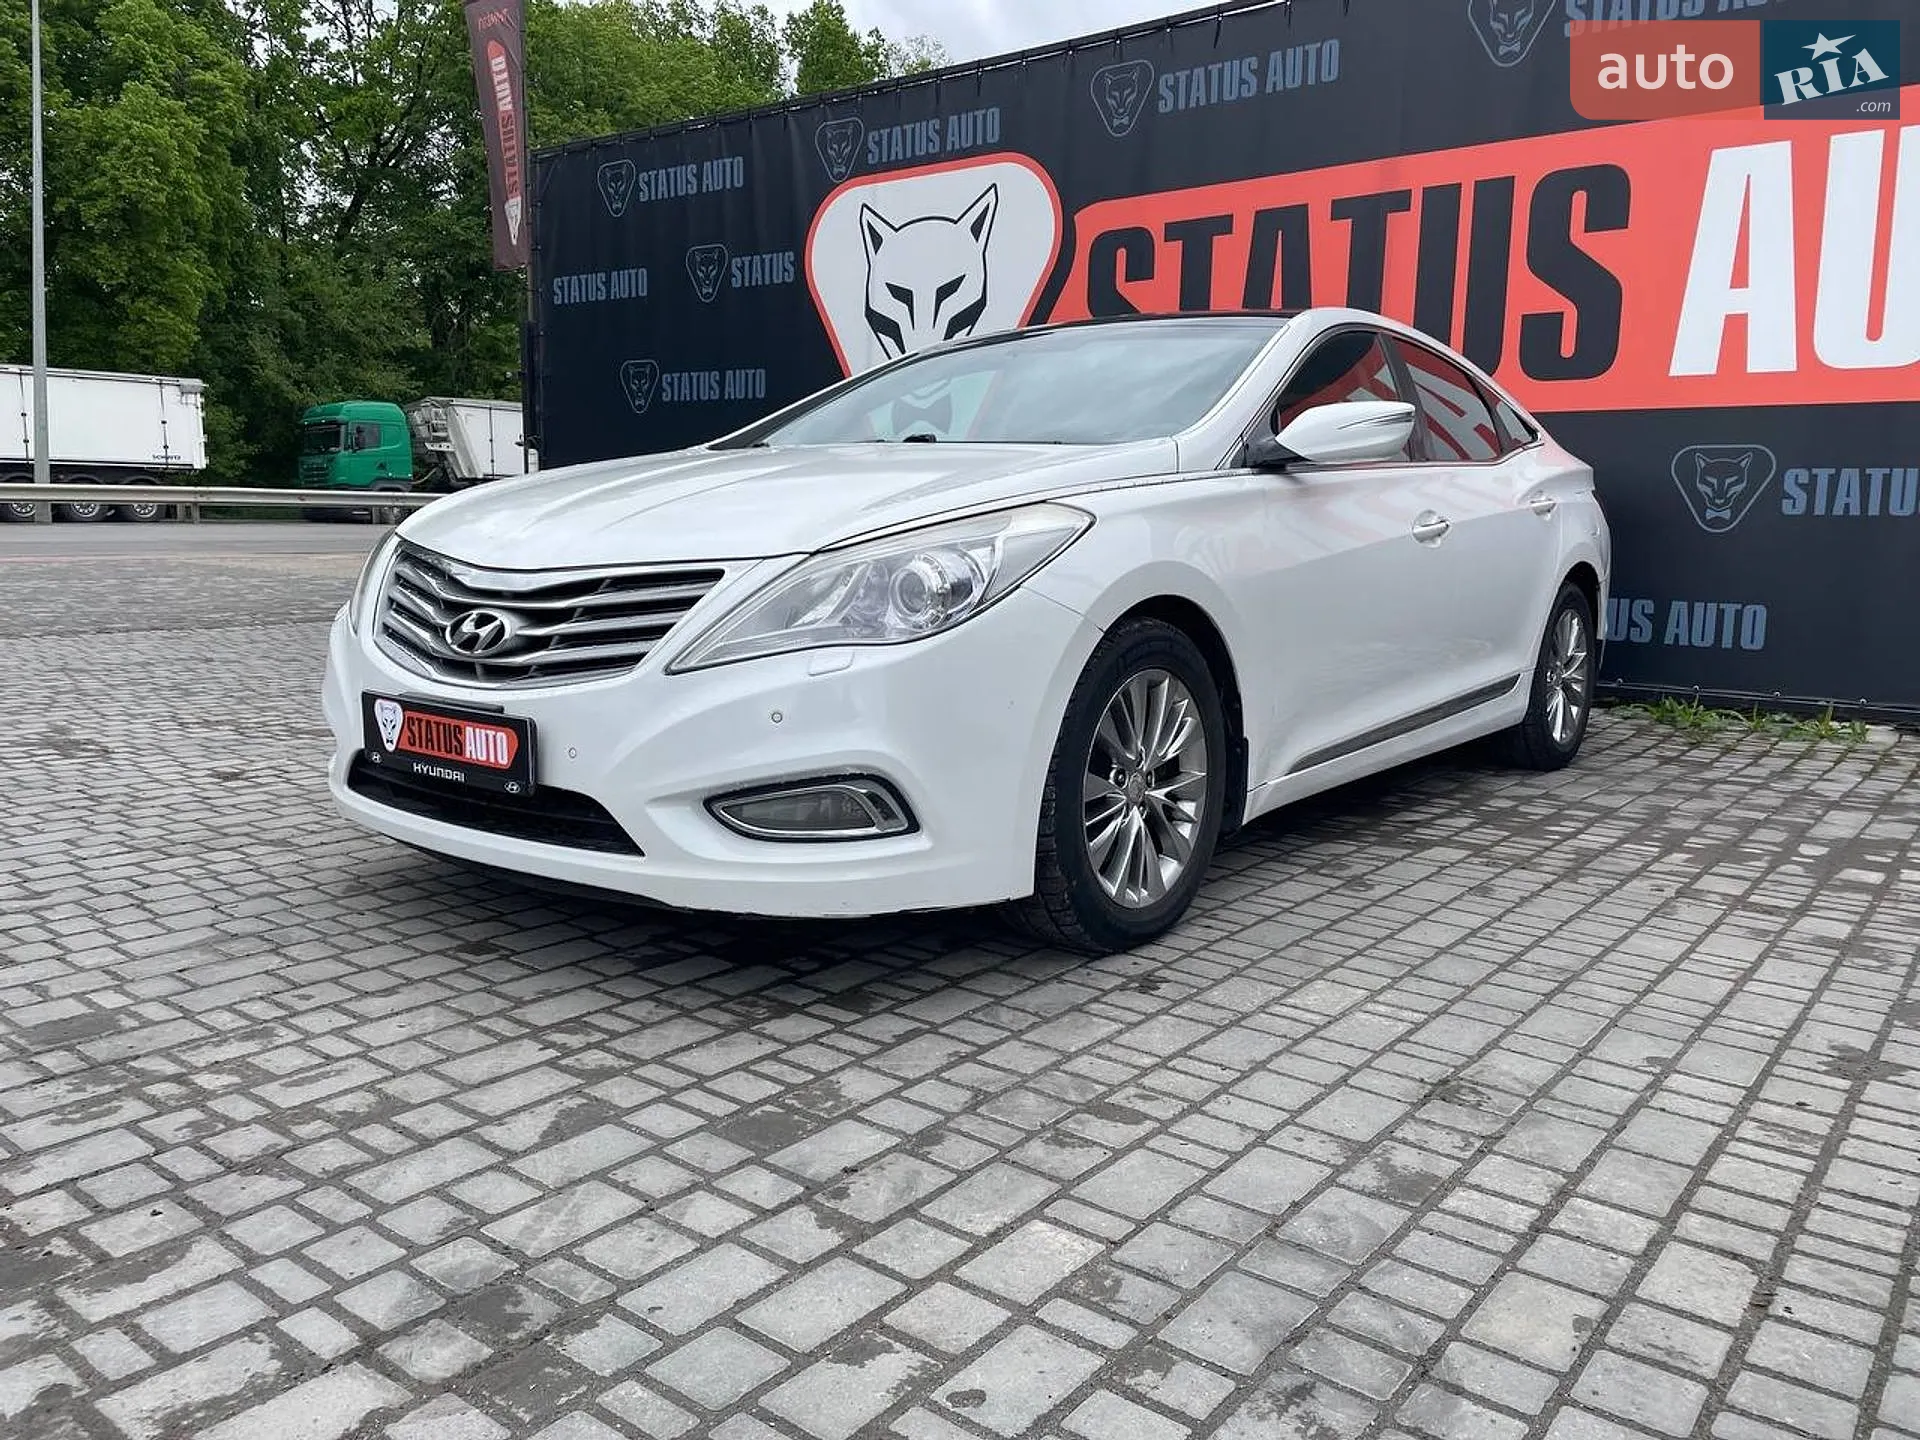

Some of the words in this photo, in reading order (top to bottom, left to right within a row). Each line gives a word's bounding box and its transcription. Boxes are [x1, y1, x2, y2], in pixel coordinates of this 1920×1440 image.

[490, 56, 513, 111] AUTO
[1158, 57, 1258, 113] STATUS
[1266, 39, 1341, 94] AUTO
[501, 112, 520, 199] STATUS
[867, 122, 941, 164] STATUS
[946, 107, 1001, 151] AUTO
[638, 164, 698, 202] STATUS
[702, 156, 744, 191] AUTO
[553, 274, 607, 305] STATUS
[610, 268, 648, 300] AUTO
[730, 251, 795, 288] STATUS
[1087, 163, 1631, 382] STATUS
[661, 369, 721, 402] STATUS
[724, 369, 767, 400] AUTO
[1781, 468, 1920, 516] STATU
[1663, 601, 1768, 650] AUTO
[406, 716, 464, 756] STATUS
[465, 726, 508, 765] AUTO
[413, 762, 465, 783] HYUNDAI
